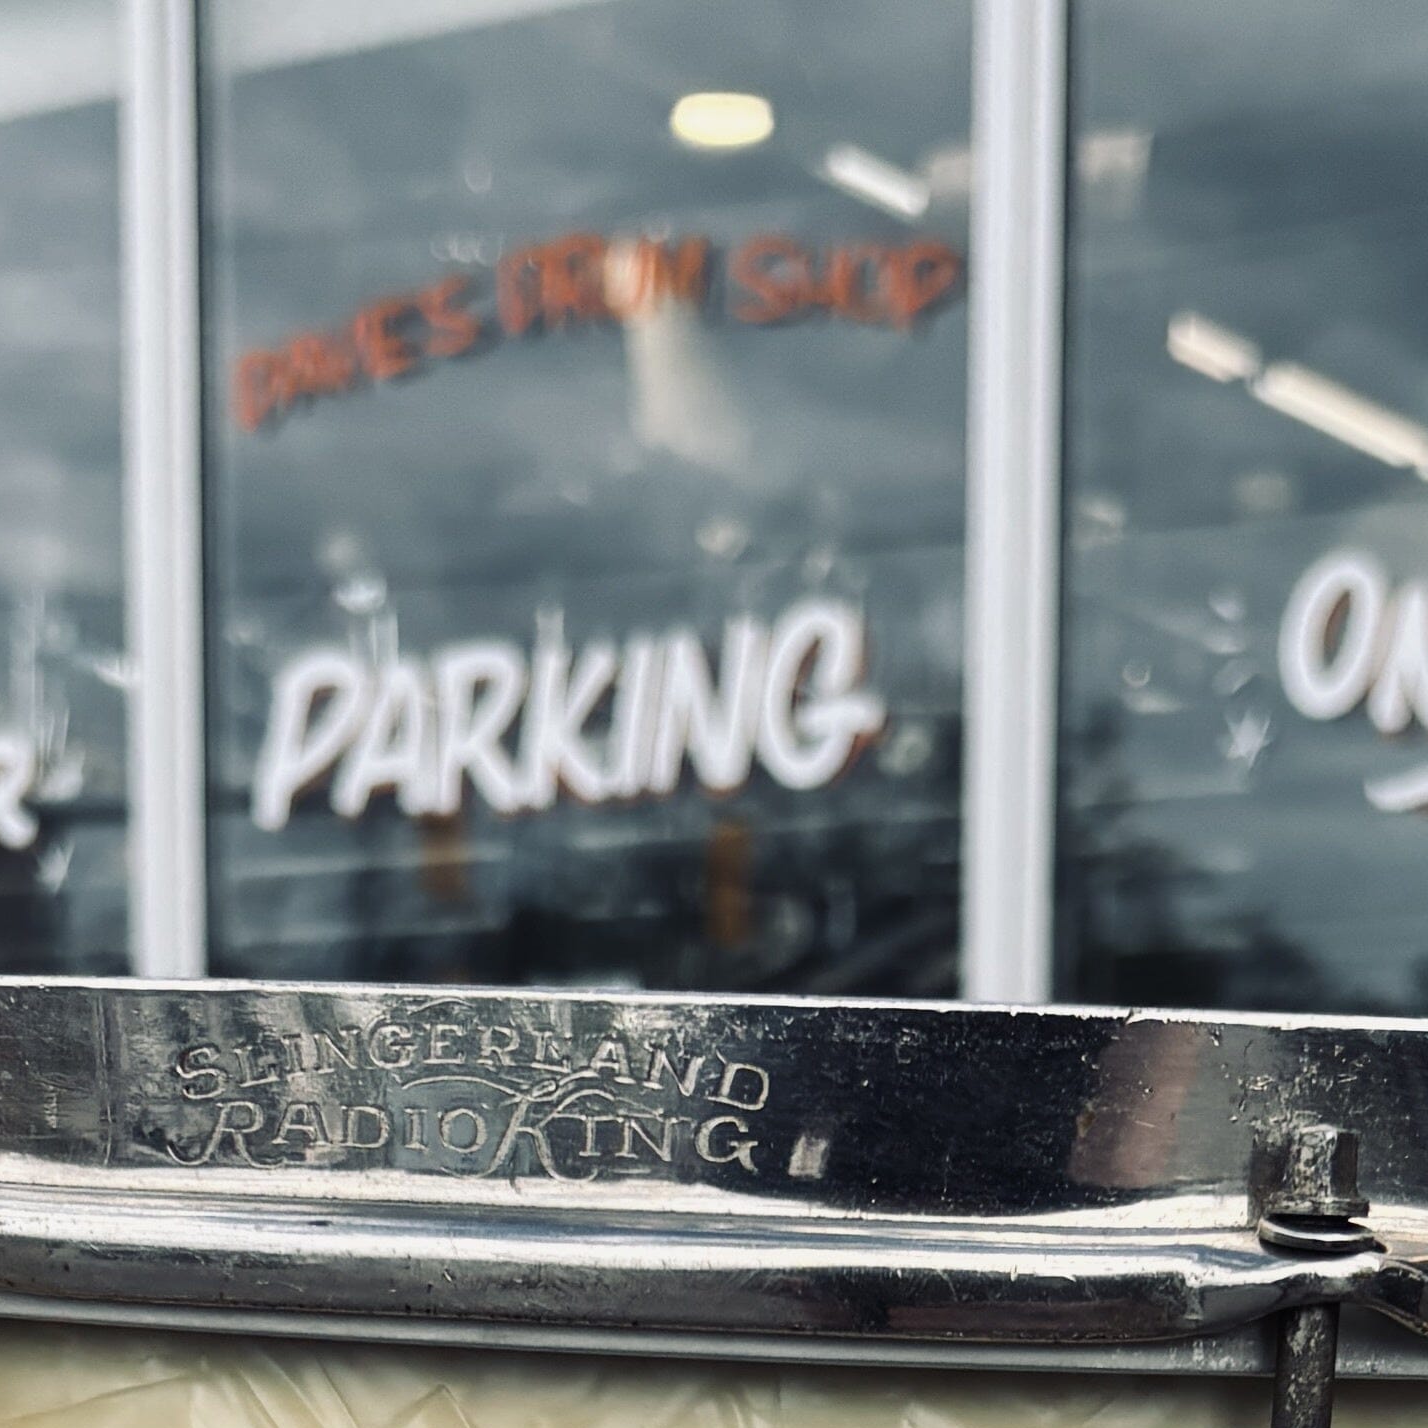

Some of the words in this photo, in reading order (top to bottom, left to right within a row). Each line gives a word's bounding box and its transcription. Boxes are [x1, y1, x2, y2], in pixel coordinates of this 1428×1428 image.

[249, 600, 888, 832] PARKING
[175, 1018, 770, 1111] SLINGERLAND
[167, 1101, 489, 1168] RADIO
[462, 1080, 760, 1183] KING
